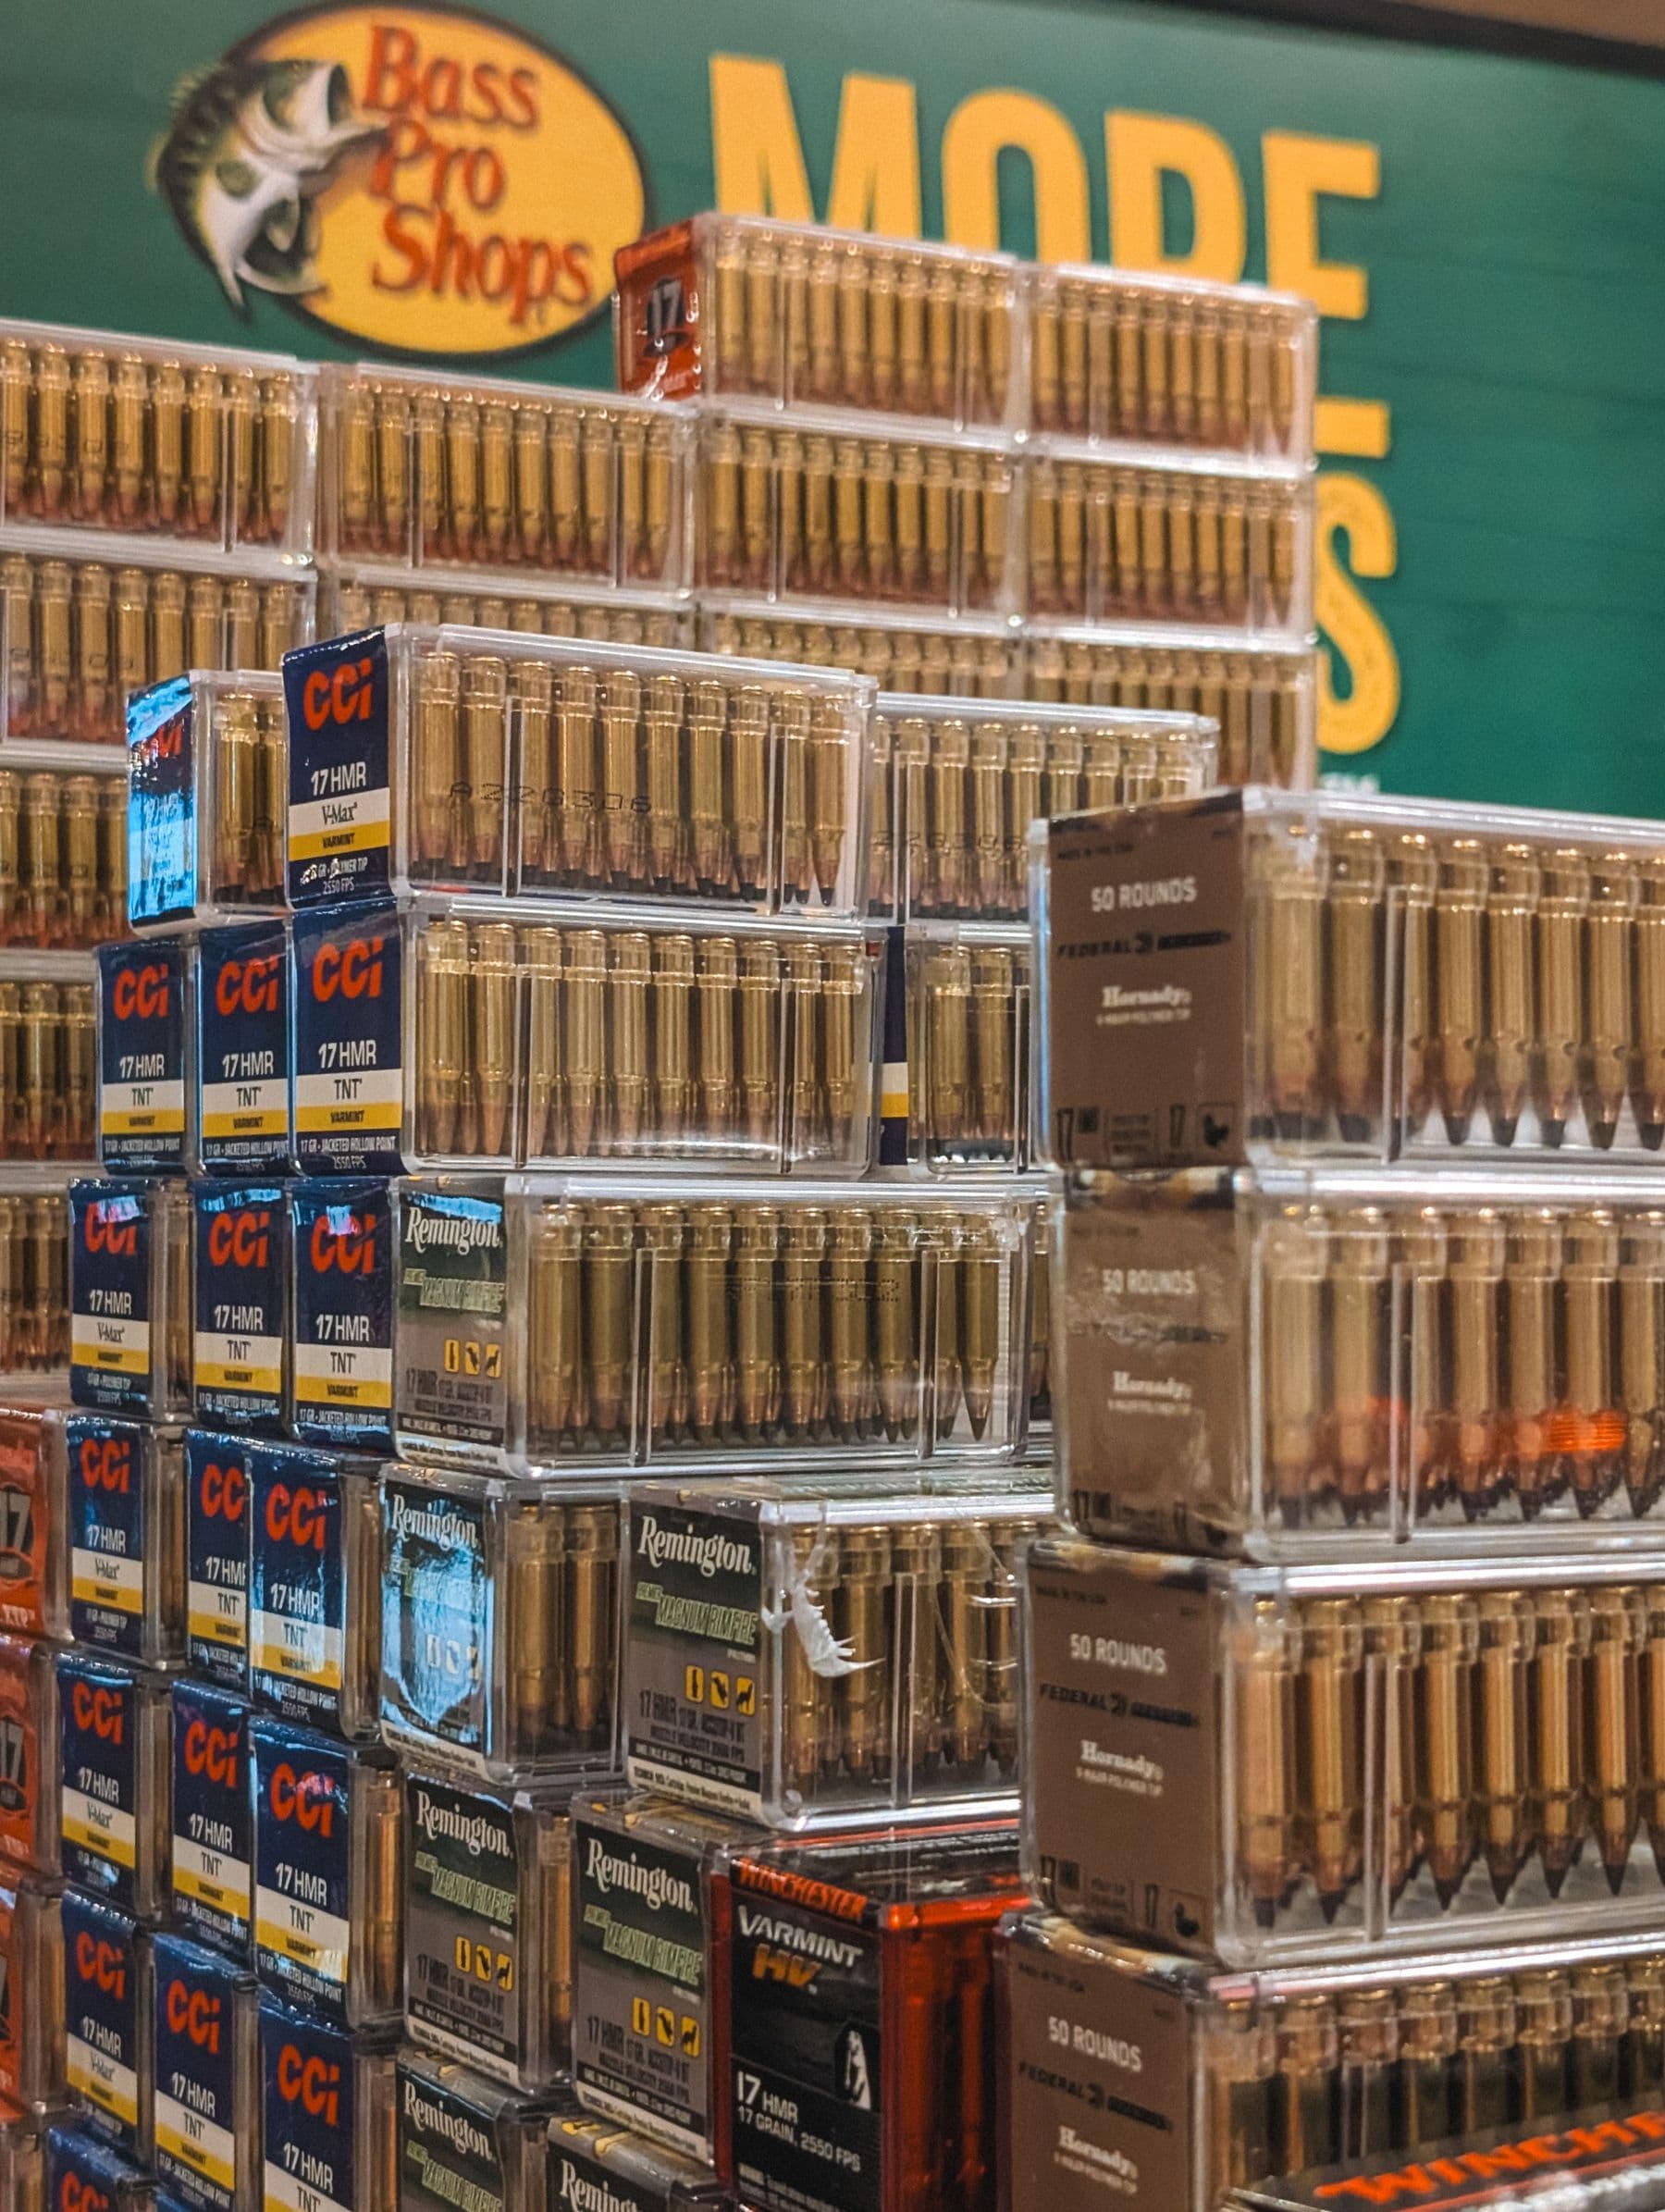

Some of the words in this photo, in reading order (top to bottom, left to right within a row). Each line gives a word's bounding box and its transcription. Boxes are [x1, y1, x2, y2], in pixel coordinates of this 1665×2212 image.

[363, 25, 542, 131] Bass
[372, 118, 506, 212] Pro
[372, 205, 595, 326] Shops
[709, 53, 1390, 457] MORE
[311, 768, 327, 797] 17
[331, 761, 366, 790] HMR
[322, 833, 355, 849] VARMINT
[1092, 885, 1116, 912] 50
[1118, 876, 1197, 909] ROUNDS
[1057, 936, 1131, 959] FEDERAL
[119, 1057, 133, 1079] 17
[136, 1054, 165, 1078] HMR
[222, 1054, 238, 1078] 17
[240, 1051, 274, 1077] HMR
[318, 1044, 336, 1069] 17
[339, 1040, 376, 1067] HMR
[131, 1087, 154, 1106] TNT
[236, 1087, 259, 1107] TNT
[334, 1080, 359, 1101] TNT
[331, 1110, 364, 1123] VARMINT
[376, 1135, 395, 1152] POINT
[405, 1206, 500, 1254] Remington
[1102, 1268, 1124, 1294] 50
[1127, 1268, 1197, 1295] ROUNDS
[90, 1290, 103, 1312] 17
[105, 1291, 132, 1316] HMR
[215, 1304, 230, 1328] 17
[232, 1305, 264, 1331] HMR
[316, 1315, 333, 1340] 17
[334, 1315, 370, 1341] HMR
[228, 1341, 249, 1362] TNT
[330, 1353, 354, 1375] TNT
[201, 1464, 245, 1521] CC
[88, 1526, 100, 1549] 17
[101, 1527, 127, 1551] HMR
[392, 1494, 478, 1551] Remington
[637, 1516, 754, 1576] Remington
[206, 1556, 220, 1581] 17
[217, 1592, 238, 1616] TNT
[271, 1583, 287, 1611] 17
[289, 1586, 321, 1619] HMR
[284, 1624, 305, 1648] TNT
[707, 1603, 758, 1646] RIMFIRE
[1070, 1633, 1092, 1661] 50
[1095, 1637, 1167, 1675] ROUNDS
[1040, 1682, 1107, 1712] FEDERAL
[79, 1767, 92, 1791] 17
[93, 1772, 119, 1803] HMR
[189, 1814, 204, 1841] 17
[205, 1819, 233, 1853] HMR
[417, 1790, 512, 1855] Remington
[202, 1853, 221, 1876] TNT
[586, 1838, 696, 1913] Remington
[276, 1863, 293, 1891] 17
[295, 1869, 327, 1906] HMR
[741, 1857, 869, 1921] WINCHESTER
[290, 1905, 313, 1934] TNT
[738, 1905, 863, 1968] VARMINT
[752, 1944, 821, 1989] HV
[82, 2015, 95, 2040] 17
[96, 2023, 122, 2058] HMR
[1049, 2016, 1069, 2046] 50
[1073, 2025, 1142, 2072] ROUNDS
[172, 2072, 186, 2098] 17
[187, 2081, 216, 2118] HMR
[738, 2070, 760, 2107] 17
[762, 2090, 799, 2125] HMR
[184, 2113, 204, 2140] TNT
[404, 2080, 493, 2161] Remington
[738, 2106, 754, 2125] 17
[800, 2132, 834, 2161] 2550
[835, 2146, 861, 2173] FPS
[283, 2142, 300, 2171] 17
[301, 2151, 334, 2193] HMR
[61, 2170, 108, 2212] CC
[297, 2186, 320, 2212] TNT
